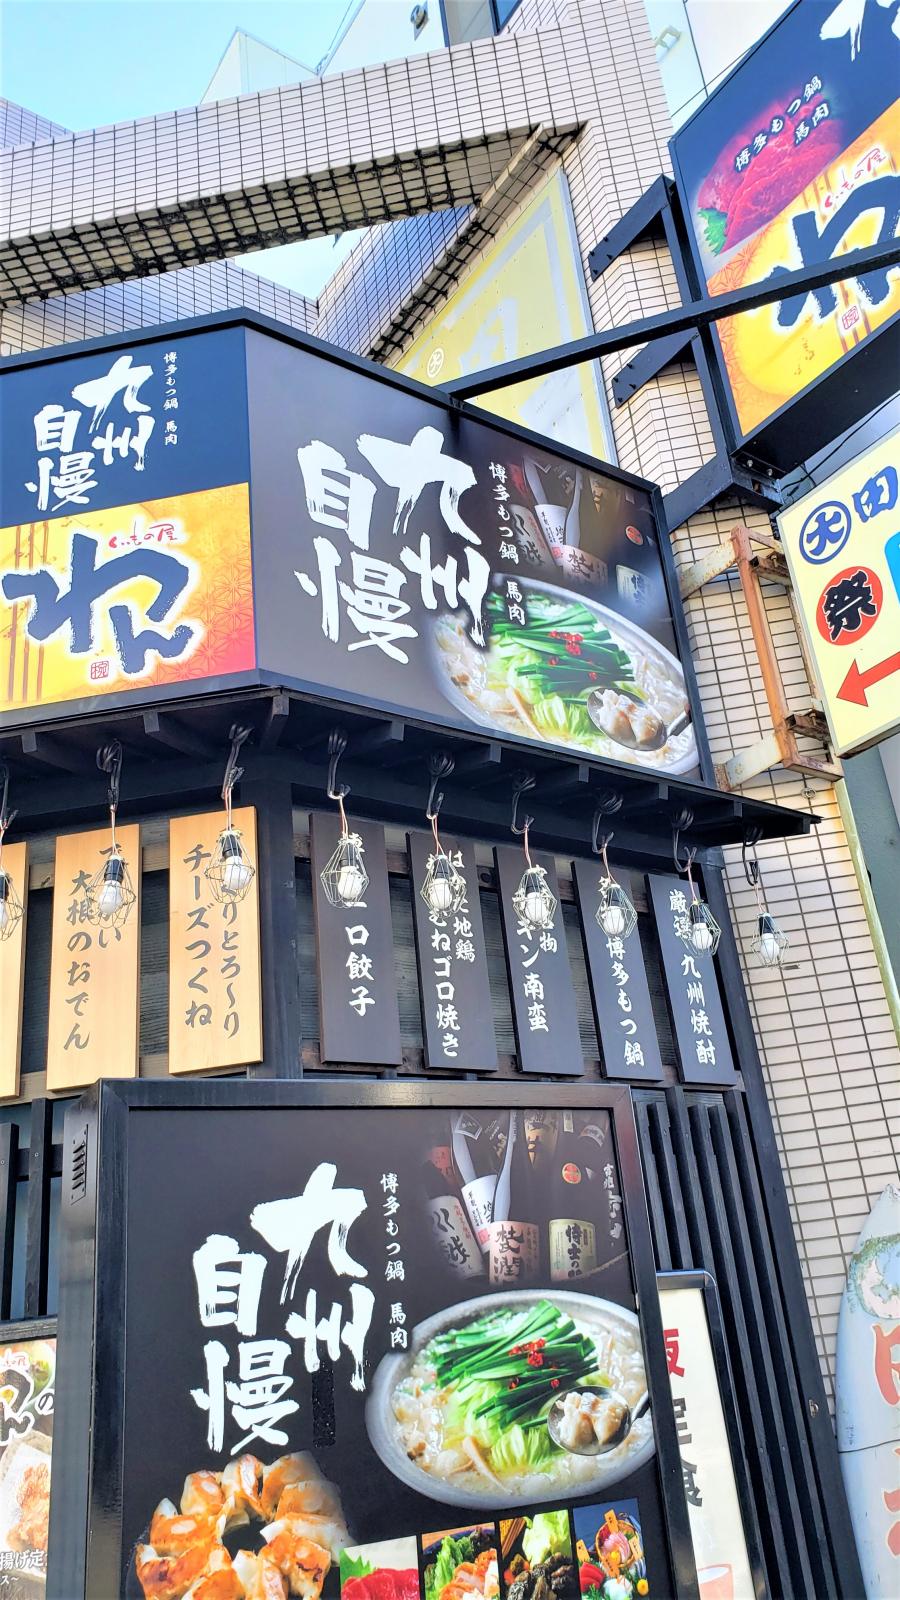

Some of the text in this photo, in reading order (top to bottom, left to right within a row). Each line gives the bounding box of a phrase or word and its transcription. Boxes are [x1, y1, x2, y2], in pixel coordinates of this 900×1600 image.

[735, 75, 822, 171] 博多もつ鍋
[795, 103, 829, 144] 馬肉
[25, 404, 98, 511] 自慢
[72, 355, 155, 472] 九州
[163, 351, 178, 446] 博多もつ鍋 馬肉
[108, 520, 178, 548] くいもの屋
[294, 439, 418, 664] 自慢
[357, 426, 491, 648] 九州
[489, 461, 527, 625] 博多もつ鍋 馬肉
[823, 570, 877, 643] 祭
[64, 870, 94, 1050] 大根のおでん
[183, 844, 214, 1029] チーズつくね
[250, 1162, 375, 1391] 九州
[380, 1172, 407, 1349] 博多もつ鍋 馬肉
[190, 1233, 300, 1456] 自慢
[0, 1549, 47, 1570] 揚げ定
